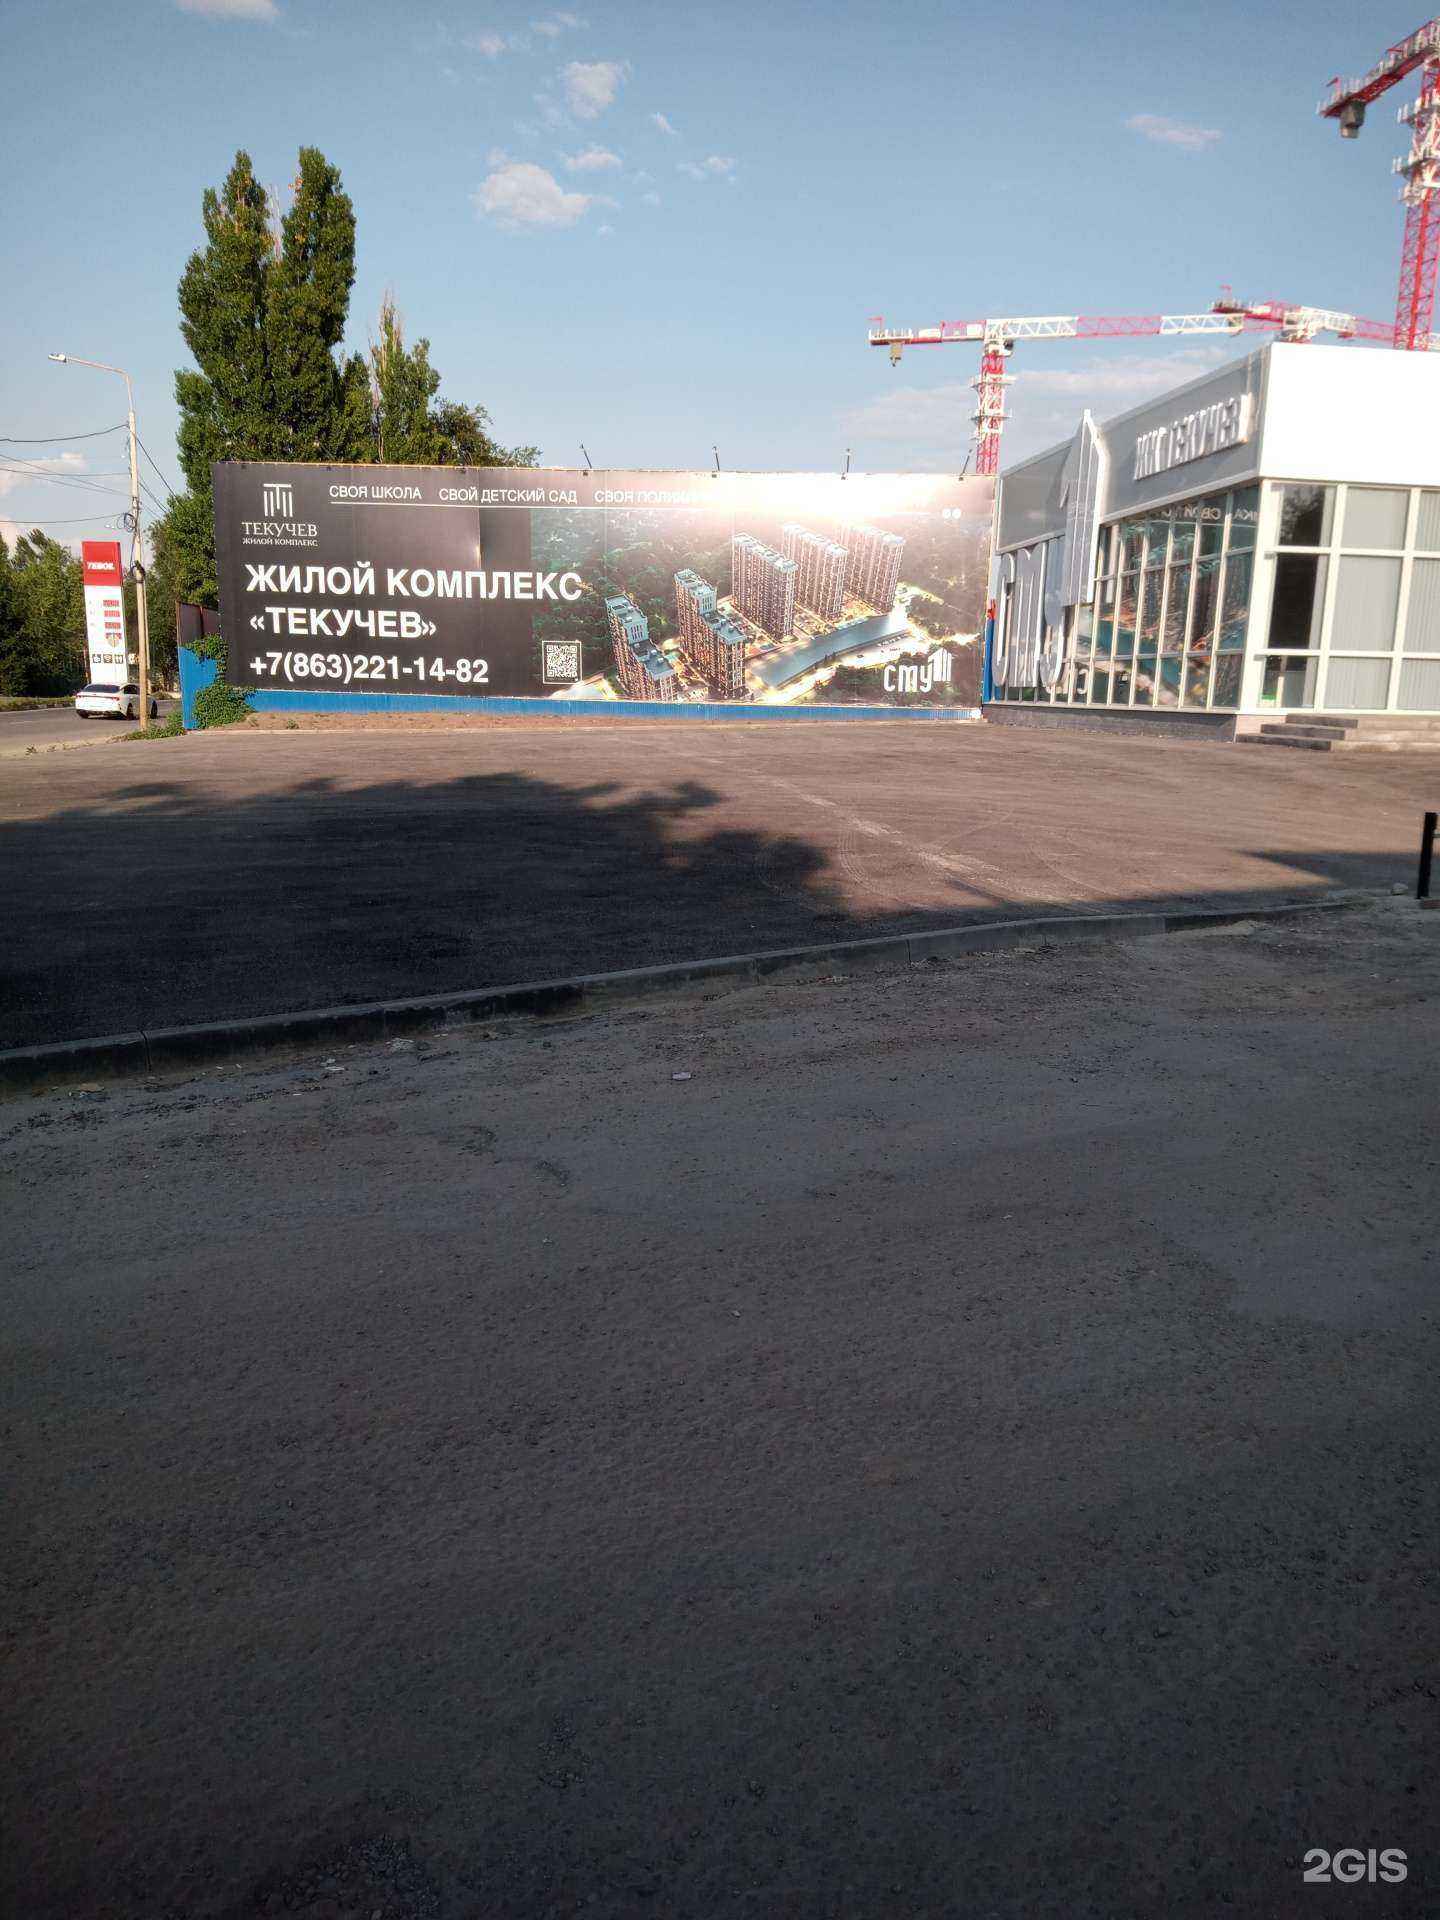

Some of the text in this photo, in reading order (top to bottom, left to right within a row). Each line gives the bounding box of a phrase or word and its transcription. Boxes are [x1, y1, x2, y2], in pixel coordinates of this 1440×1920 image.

[329, 485, 423, 500] СВОЯ ШКОЛА
[438, 485, 578, 504] СВОЙ ДЕТСКИЙ САД
[594, 490, 634, 503] СВОЯ
[241, 521, 318, 538] ТЕКУЧЕВ
[242, 536, 319, 547] ЖИЛОЙ КОМПЛЕКС
[245, 561, 582, 601] ЖИЛОЙ КОМПЛЕКС
[250, 606, 437, 639] «ТЕКУЧЕВ»
[250, 651, 489, 684] +7(863)221-14-82
